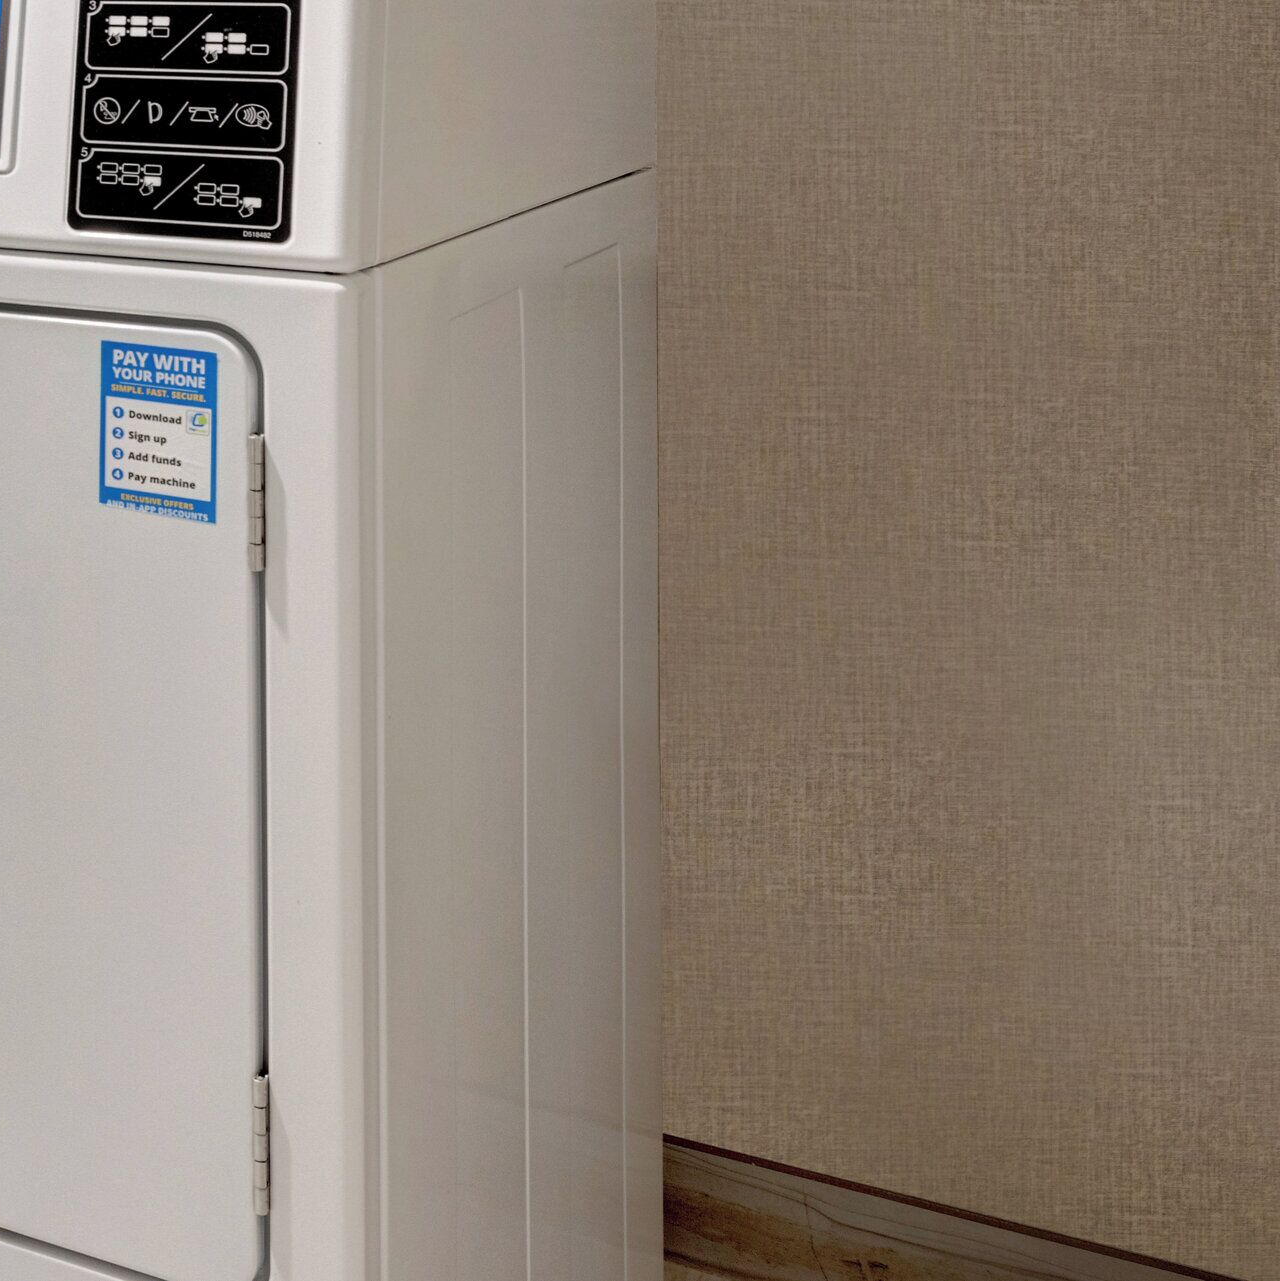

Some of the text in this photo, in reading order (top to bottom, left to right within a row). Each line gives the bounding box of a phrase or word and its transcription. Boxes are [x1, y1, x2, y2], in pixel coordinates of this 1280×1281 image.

[89, 0, 97, 11] 3
[84, 74, 92, 83] 4
[81, 147, 89, 157] 5
[112, 348, 206, 374] PAY WITH
[112, 366, 206, 390] YOUR PHONE
[111, 383, 207, 403] SIMPLE. FAST. SECURE.
[128, 410, 182, 425] Download
[128, 430, 151, 444] Sign
[153, 435, 167, 446] up
[128, 451, 149, 463] Add
[151, 454, 182, 467] funds
[128, 472, 146, 484] Pay
[149, 476, 196, 490] machine
[120, 492, 194, 511] EXCLUSIVE OFFERS
[106, 499, 209, 522] AND IN-APP DISCOUNTS
